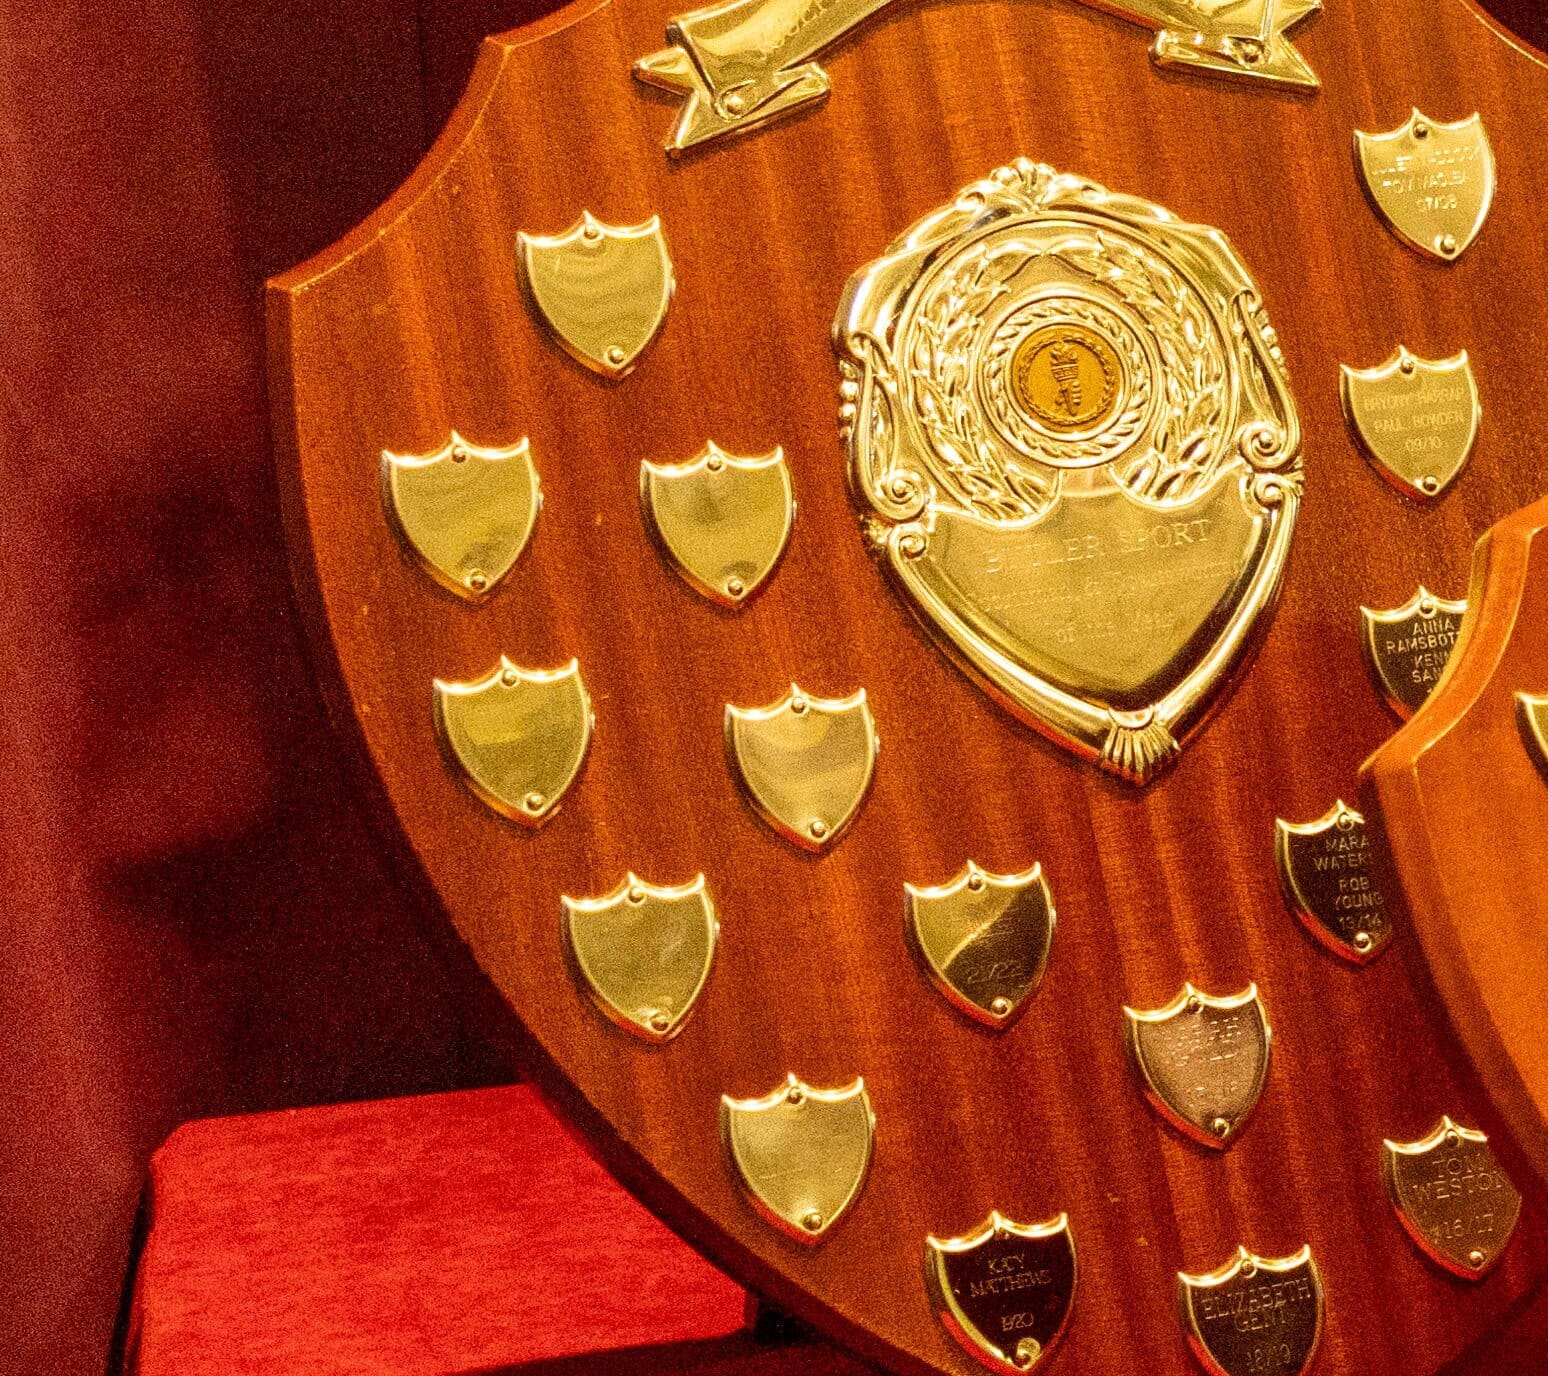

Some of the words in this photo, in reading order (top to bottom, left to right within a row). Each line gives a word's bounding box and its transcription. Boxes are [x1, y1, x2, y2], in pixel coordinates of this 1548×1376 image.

[1373, 417, 1409, 433] PAUL
[1412, 410, 1466, 431] BOWDEN
[1404, 435, 1442, 452] 09/10
[1118, 518, 1212, 555] SPORT
[1412, 617, 1455, 637] ANNA
[1385, 630, 1461, 656] RAMSBOT
[1324, 834, 1370, 853] MARA
[1338, 876, 1370, 893] ROB
[1334, 890, 1385, 911] YOUNG
[969, 1268, 1053, 1299] MATTHEWS
[1200, 1276, 1312, 1321] ELIZABETH
[1233, 1307, 1287, 1334] GENT
